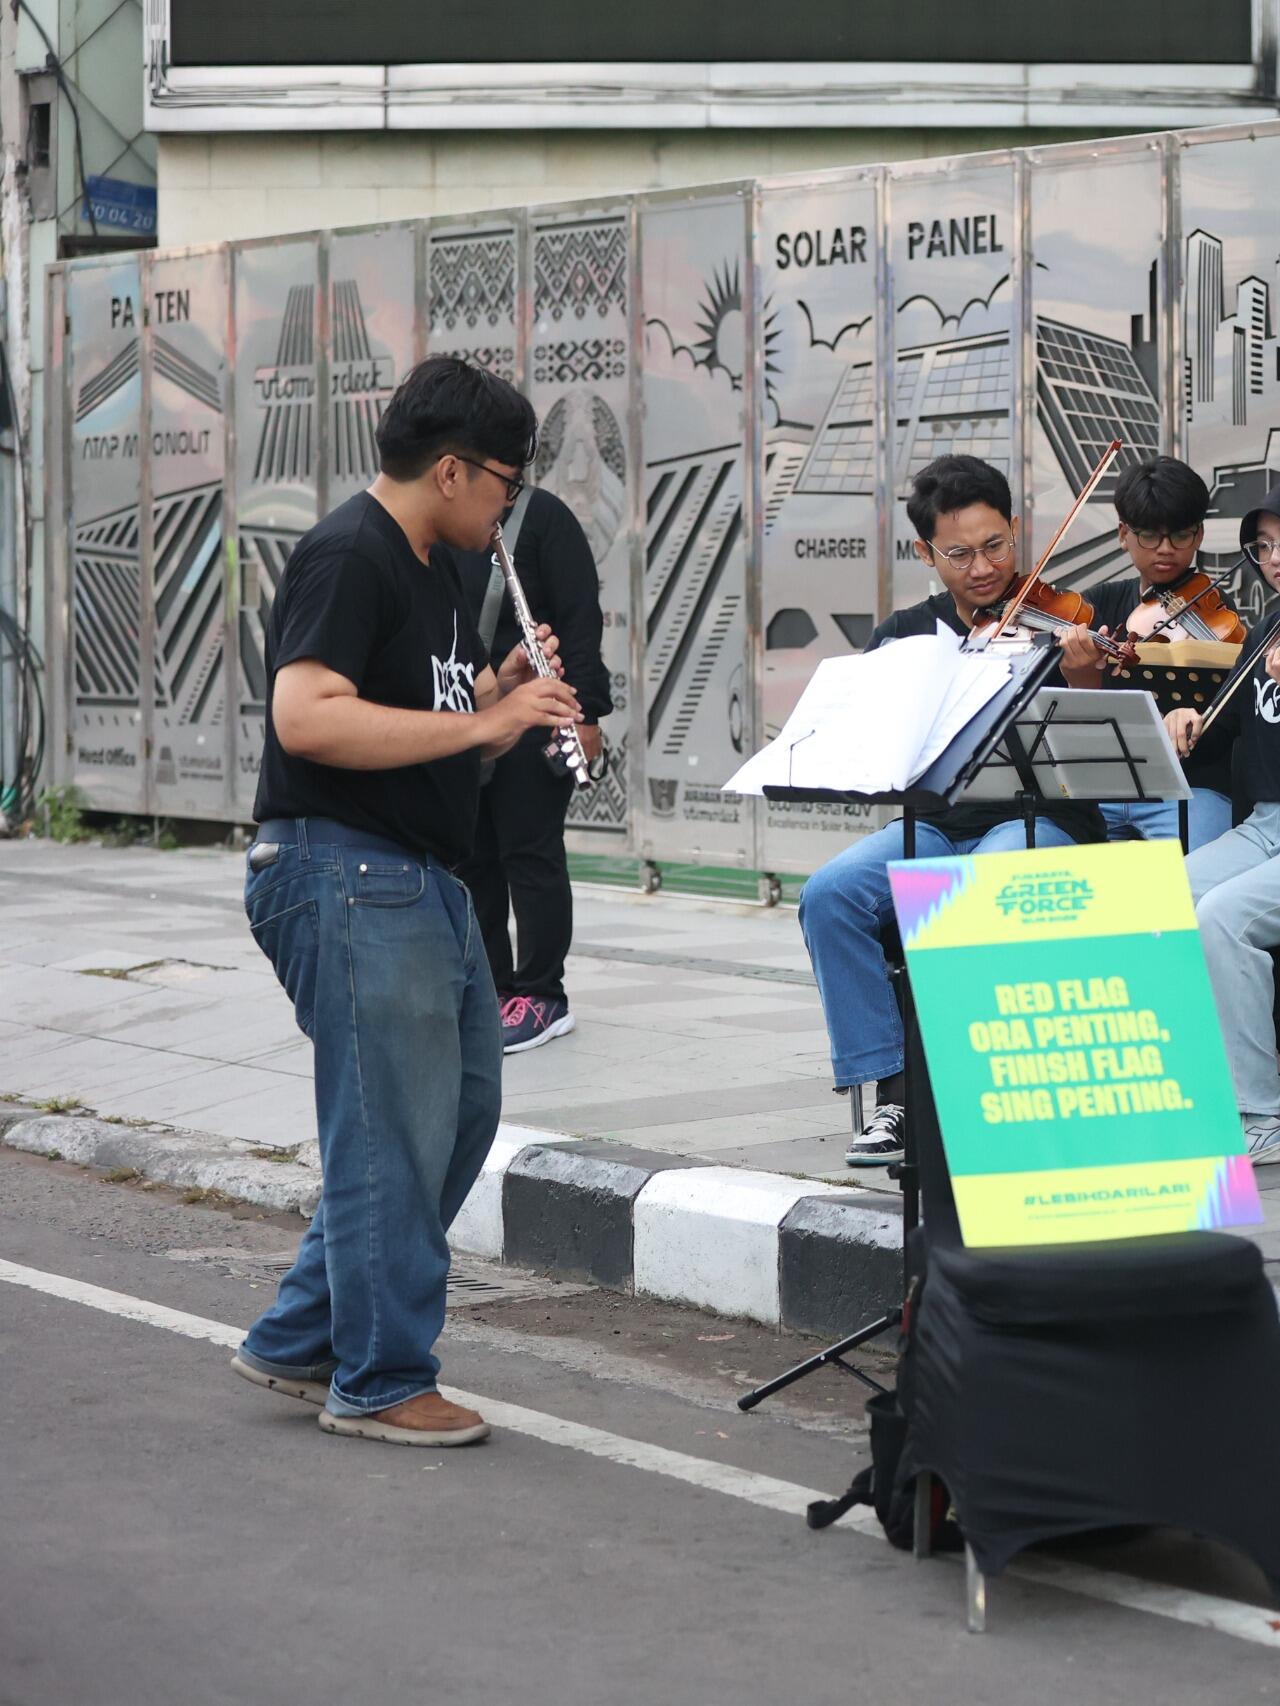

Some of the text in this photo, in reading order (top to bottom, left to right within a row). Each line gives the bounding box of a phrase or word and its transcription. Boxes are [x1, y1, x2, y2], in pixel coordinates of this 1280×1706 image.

[776, 214, 1004, 270] SOLAR PANEL
[795, 538, 867, 559] CHARGER
[996, 879, 1094, 899] GREEN
[996, 896, 1094, 916] FORCE
[994, 976, 1131, 1016] RED FLAG
[968, 1018, 1033, 1053] ORA
[989, 1045, 1164, 1087] FINISH FLAG
[980, 1078, 1194, 1124] SING PENTING.
